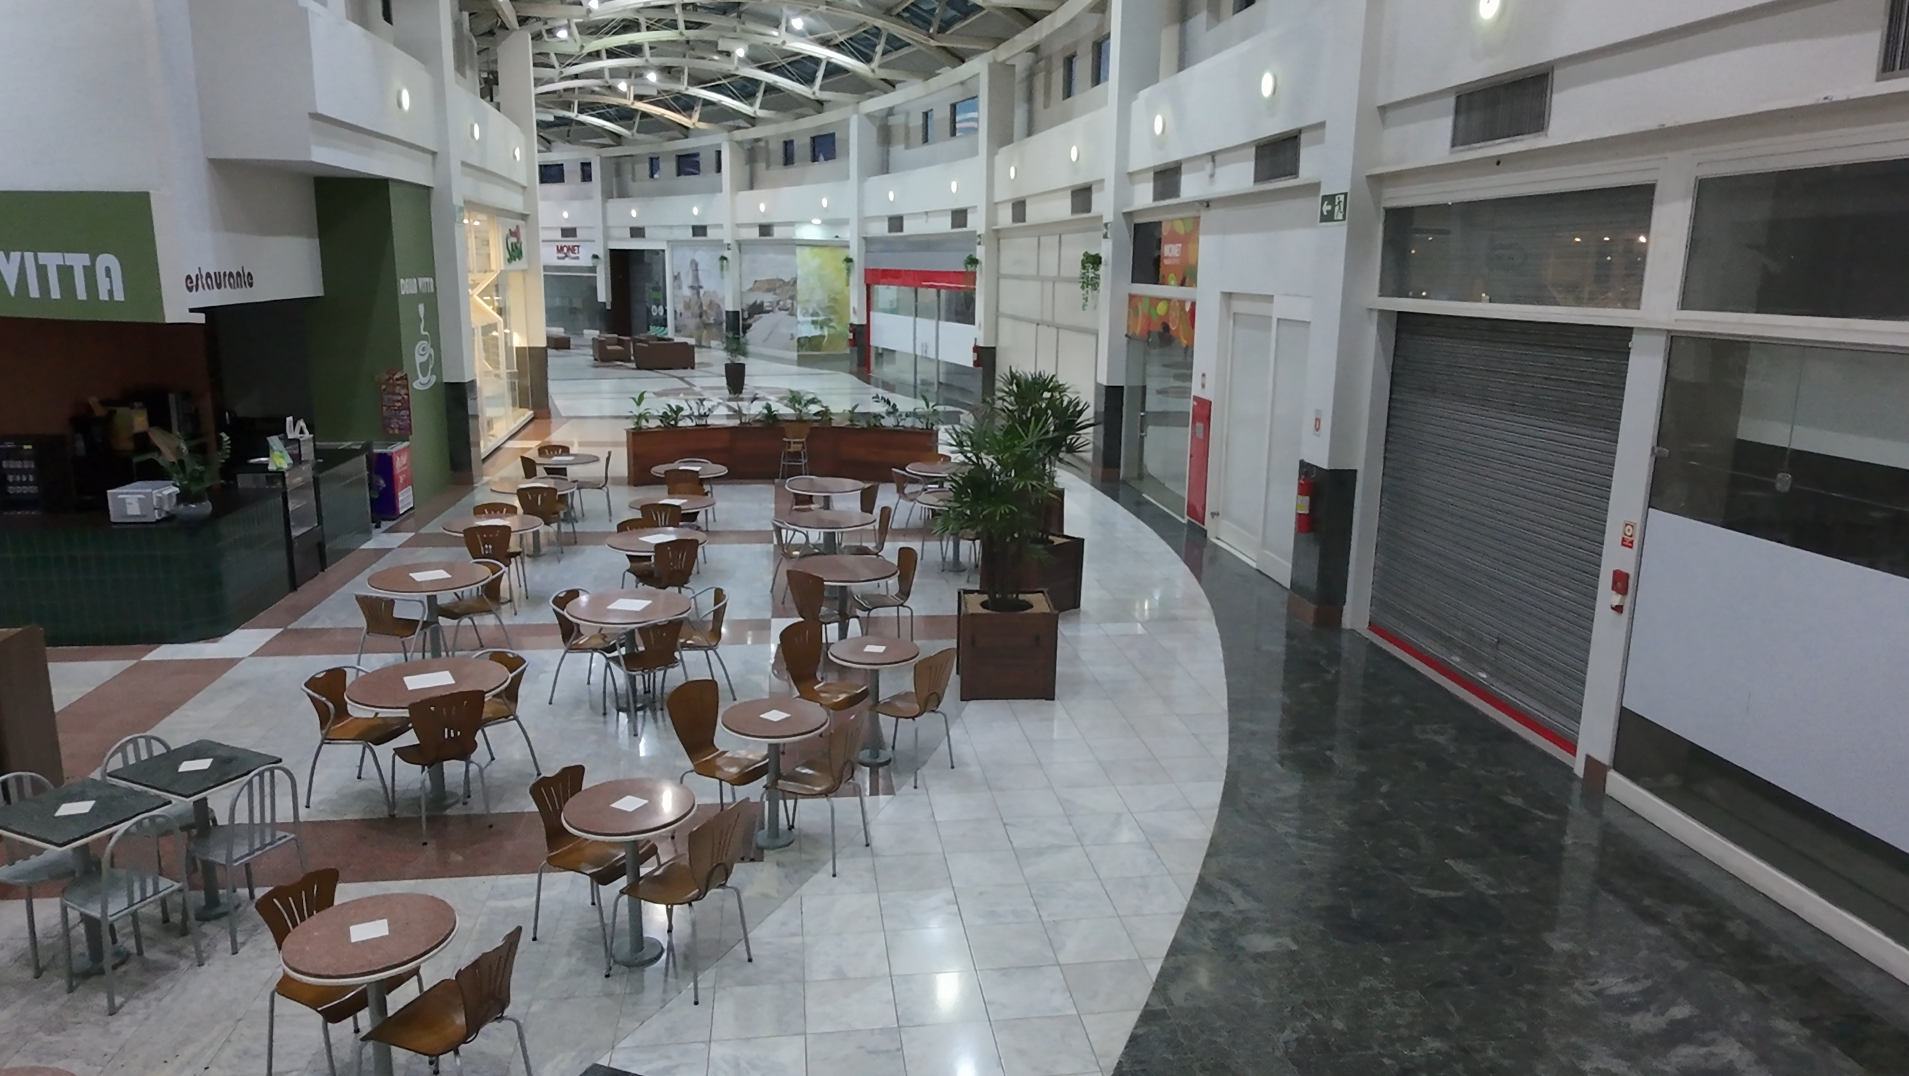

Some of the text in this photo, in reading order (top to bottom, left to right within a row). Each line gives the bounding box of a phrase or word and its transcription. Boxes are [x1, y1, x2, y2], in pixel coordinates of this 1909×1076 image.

[556, 244, 580, 254] MONET
[0, 251, 125, 301] VITTA
[185, 265, 254, 292] estaurante
